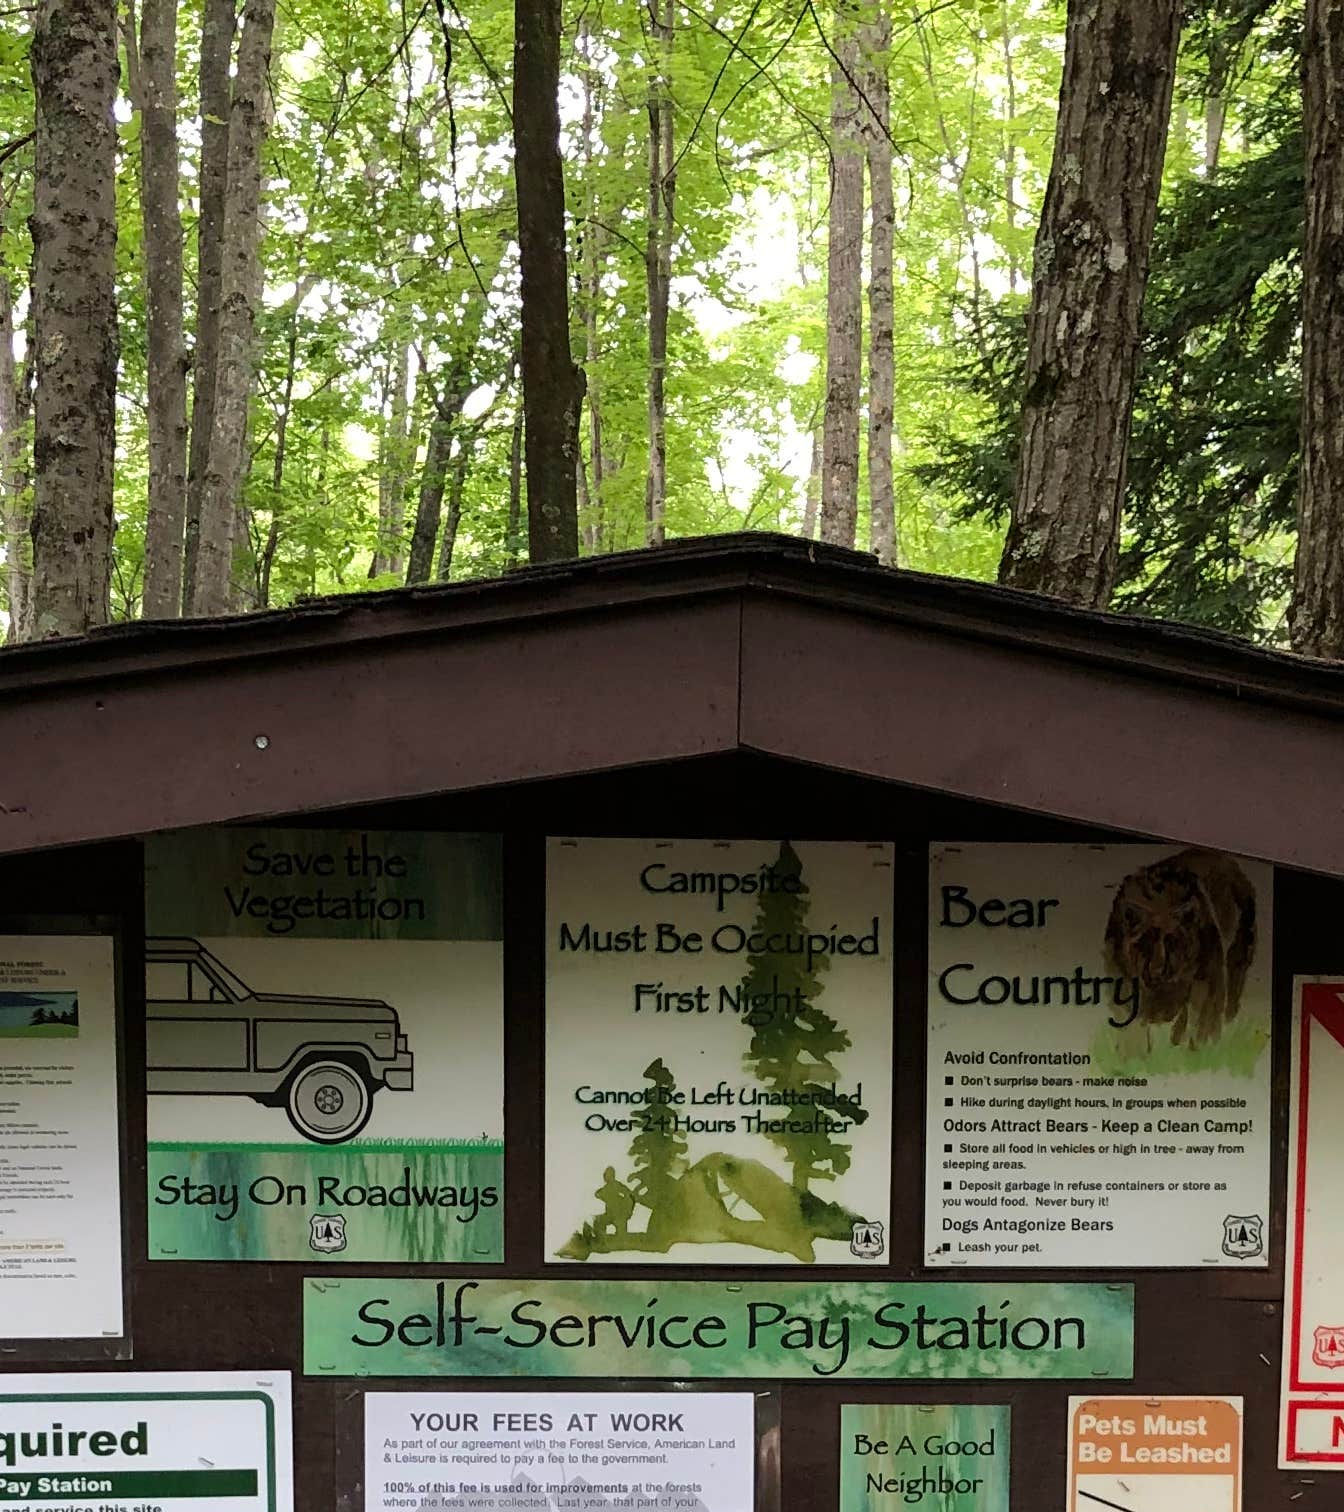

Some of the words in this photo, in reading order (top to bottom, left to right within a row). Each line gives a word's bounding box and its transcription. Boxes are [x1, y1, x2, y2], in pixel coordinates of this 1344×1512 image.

[242, 843, 335, 878] Save
[344, 834, 407, 878] the
[640, 863, 802, 911] Campsite
[224, 886, 425, 933] Vegetation
[940, 886, 1060, 928] Bear
[559, 922, 646, 953] Must
[655, 924, 703, 954] Be
[712, 916, 880, 971] Occupied
[635, 982, 710, 1013] First
[719, 975, 807, 1028] Night
[939, 964, 1140, 1027] Country
[944, 1051, 984, 1065] Avoid
[989, 1051, 1091, 1065] Confrontation
[575, 1086, 652, 1106] Cannot
[662, 1088, 687, 1106] Be
[691, 1082, 734, 1106] Left
[739, 1082, 862, 1107] Unattended
[585, 1114, 635, 1133] Over
[642, 1114, 669, 1132] 24
[674, 1115, 735, 1133] Hours
[742, 1109, 853, 1134] Thereafter
[944, 1119, 986, 1132] Odors
[991, 1119, 1041, 1132] Attract
[1046, 1119, 1088, 1132] Bears
[1101, 1120, 1139, 1135] Keep
[1144, 1122, 1152, 1132] a
[1157, 1120, 1199, 1132] Clean
[1204, 1120, 1253, 1135] Camp!
[155, 1175, 238, 1221] Stay
[249, 1176, 306, 1207] On
[318, 1167, 498, 1222] Roadways
[942, 1218, 979, 1233] Dogs
[983, 1218, 1066, 1233] Antagonize
[1071, 1218, 1114, 1231] Bears
[959, 1243, 991, 1252] Leash
[995, 1244, 1018, 1254] your
[1022, 1243, 1042, 1253] pet.
[351, 1282, 727, 1350] Self-Service
[748, 1302, 852, 1374] Pay
[867, 1300, 1085, 1350] Station
[410, 1413, 479, 1431] YOUR
[493, 1413, 553, 1431] FEES
[566, 1413, 598, 1431] AT
[610, 1413, 684, 1431] WORK
[1079, 1416, 1135, 1436] Pets
[1144, 1416, 1207, 1436] Must
[854, 1435, 888, 1456] Be
[895, 1435, 917, 1456] A
[924, 1429, 995, 1456] Good
[1079, 1443, 1111, 1463] Be
[1120, 1443, 1230, 1464] Leashed
[38, 1476, 112, 1493] Station
[866, 1466, 983, 1503] Neighbor
